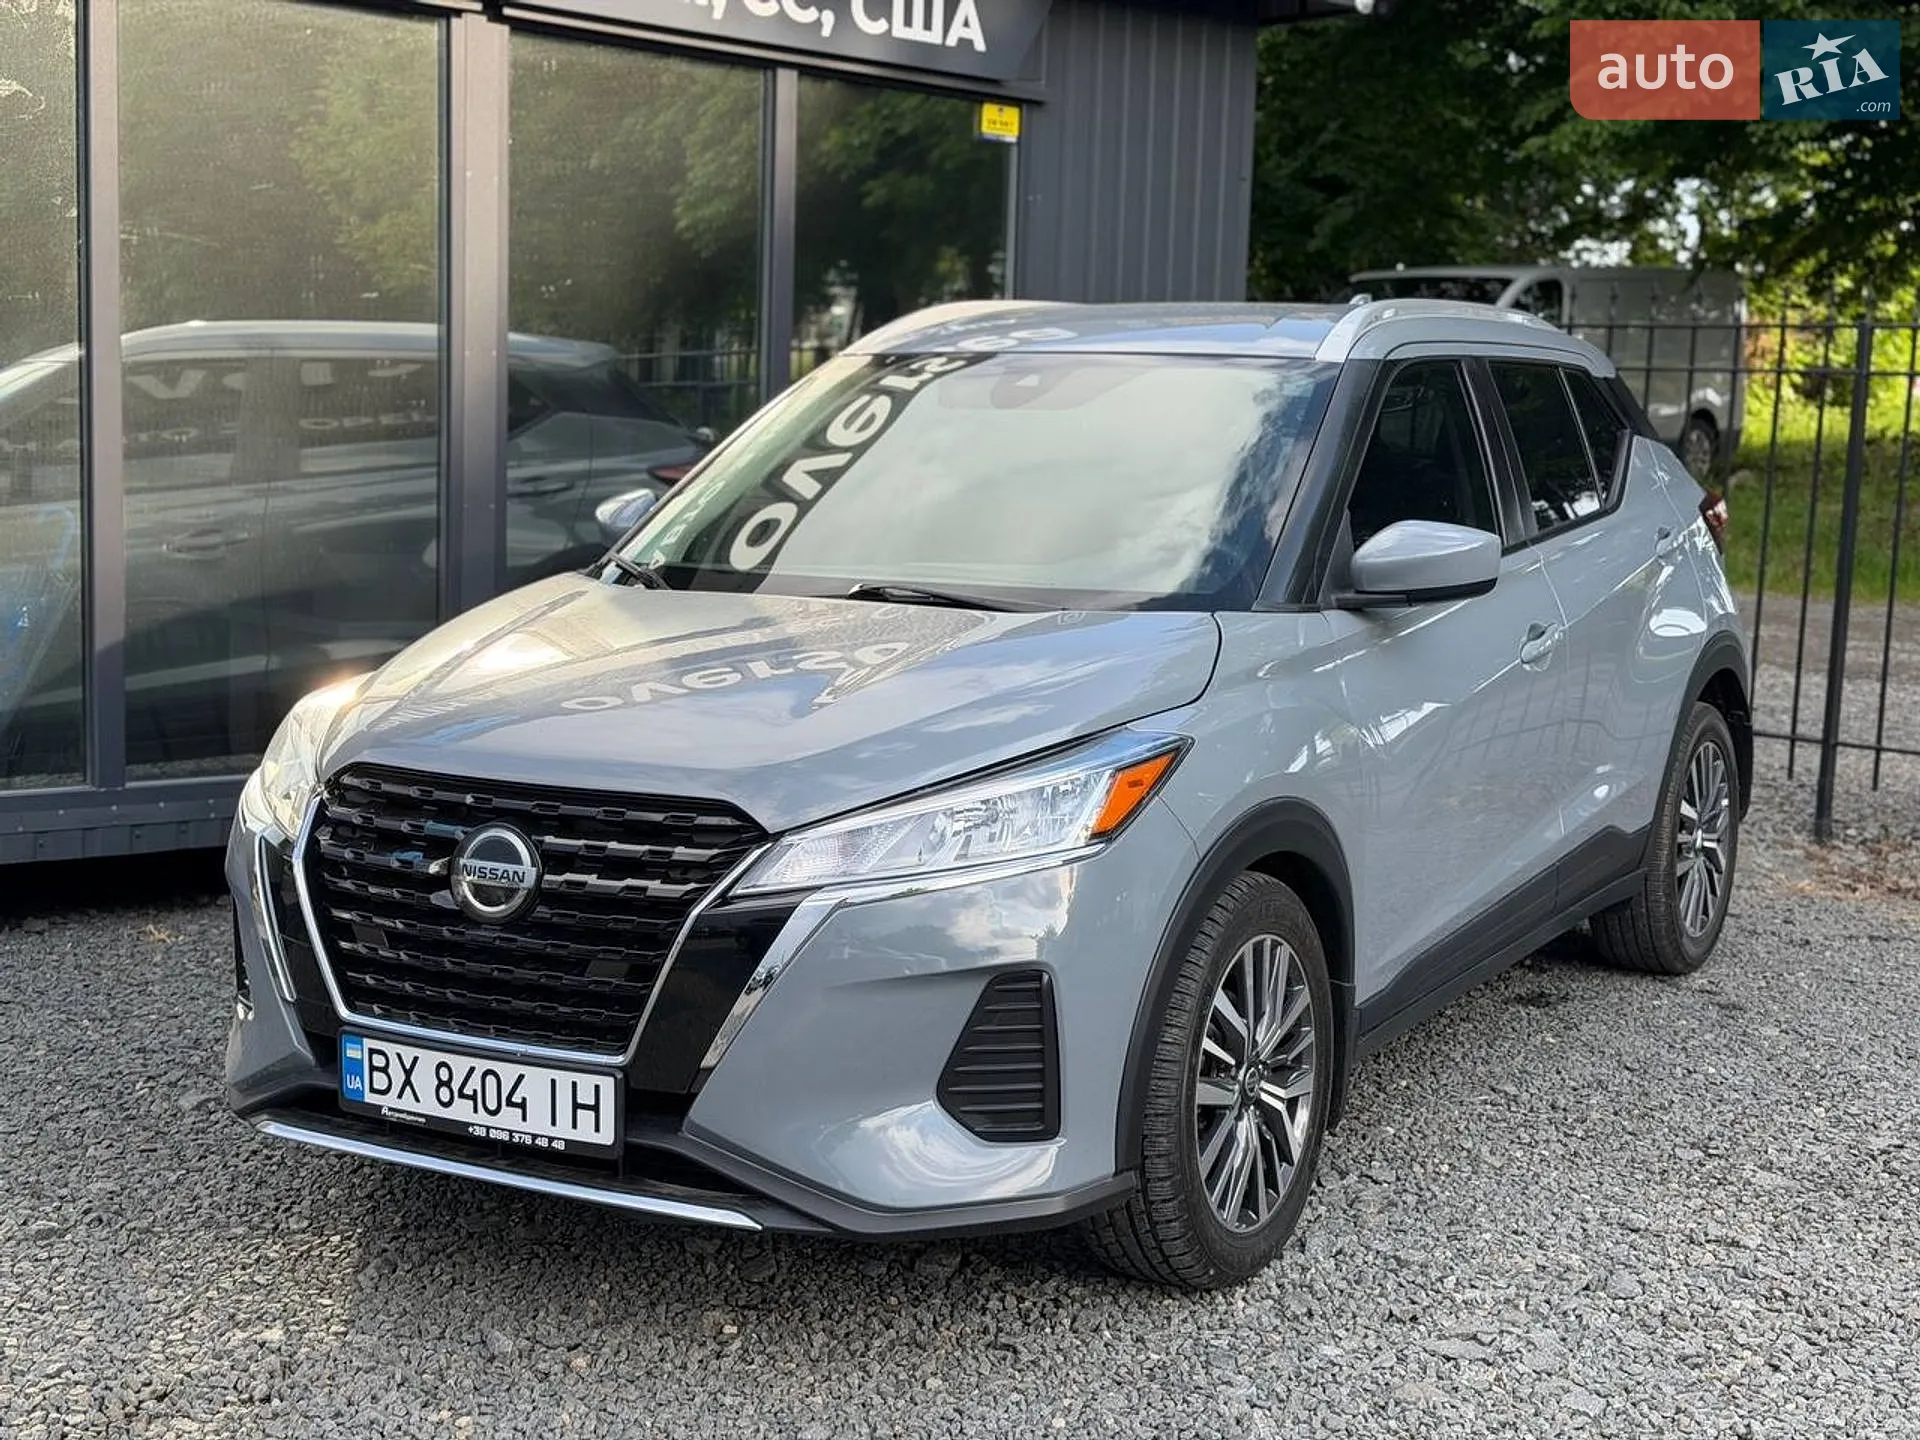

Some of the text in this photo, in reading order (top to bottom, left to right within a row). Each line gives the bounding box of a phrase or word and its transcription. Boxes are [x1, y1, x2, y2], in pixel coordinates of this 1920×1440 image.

[851, 0, 987, 52] США
[462, 863, 527, 884] NISSAN
[346, 1073, 363, 1091] UA
[367, 1047, 601, 1134] BX 8404 IH
